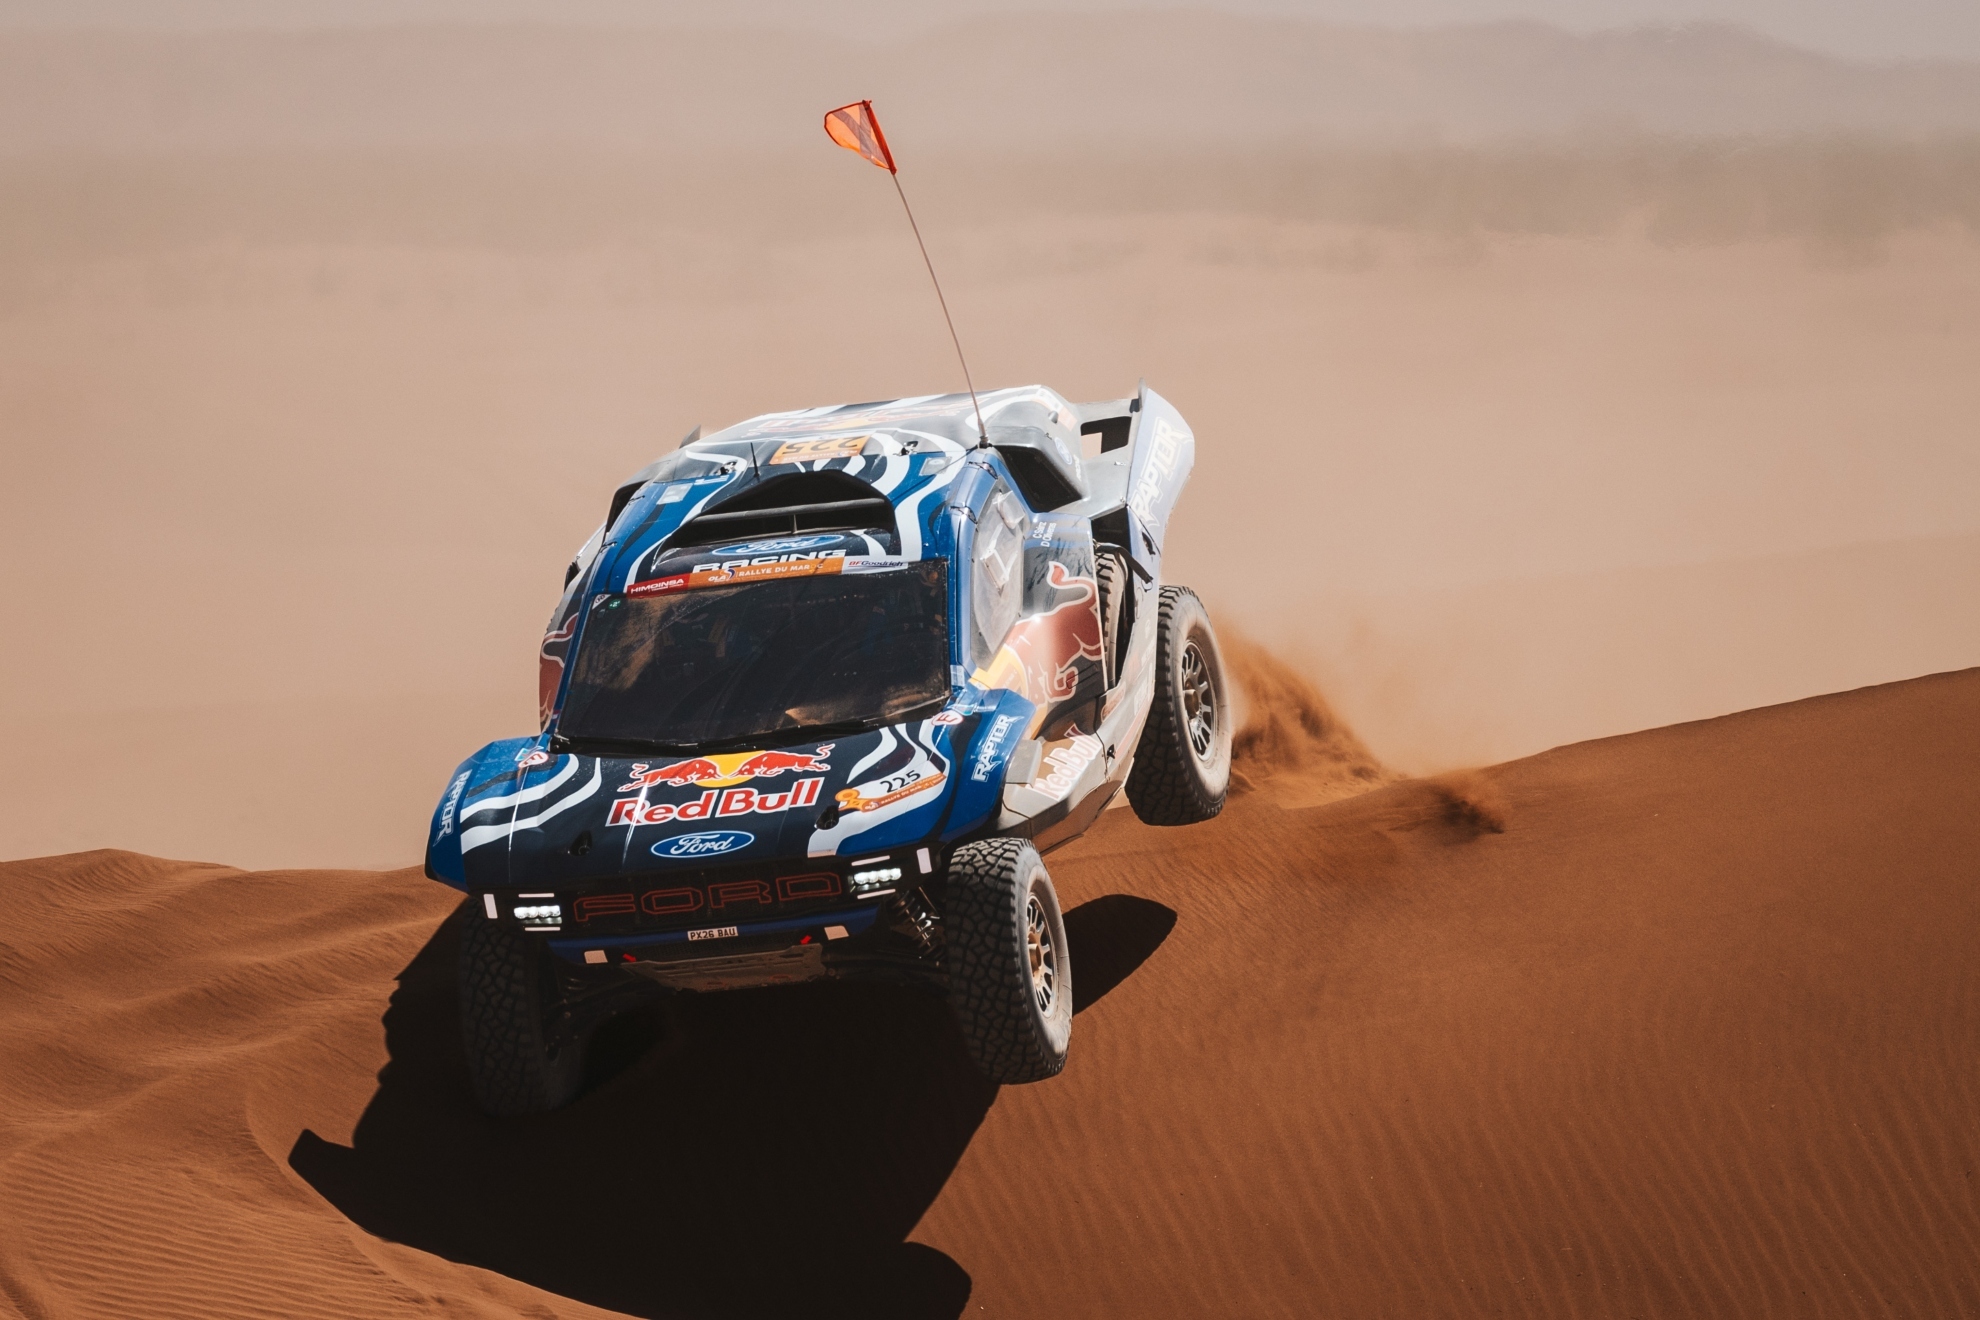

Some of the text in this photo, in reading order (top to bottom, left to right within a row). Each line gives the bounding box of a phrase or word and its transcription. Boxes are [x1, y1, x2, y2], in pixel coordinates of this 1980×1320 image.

[1129, 416, 1194, 527] RAPTOR
[692, 549, 847, 574] RACING
[739, 567, 772, 577] RALLYE
[775, 565, 788, 573] DU
[849, 559, 904, 568] BFGoodrich
[630, 578, 684, 594] HIMOINSA
[971, 713, 1025, 783] RAPTOR
[1025, 723, 1103, 802] Red Bull
[879, 769, 921, 793] 225
[432, 768, 472, 847] RAPTOR
[605, 777, 825, 827] Red Bull
[670, 834, 735, 855] Ford
[573, 872, 843, 923] FORD
[689, 928, 715, 940] PX26
